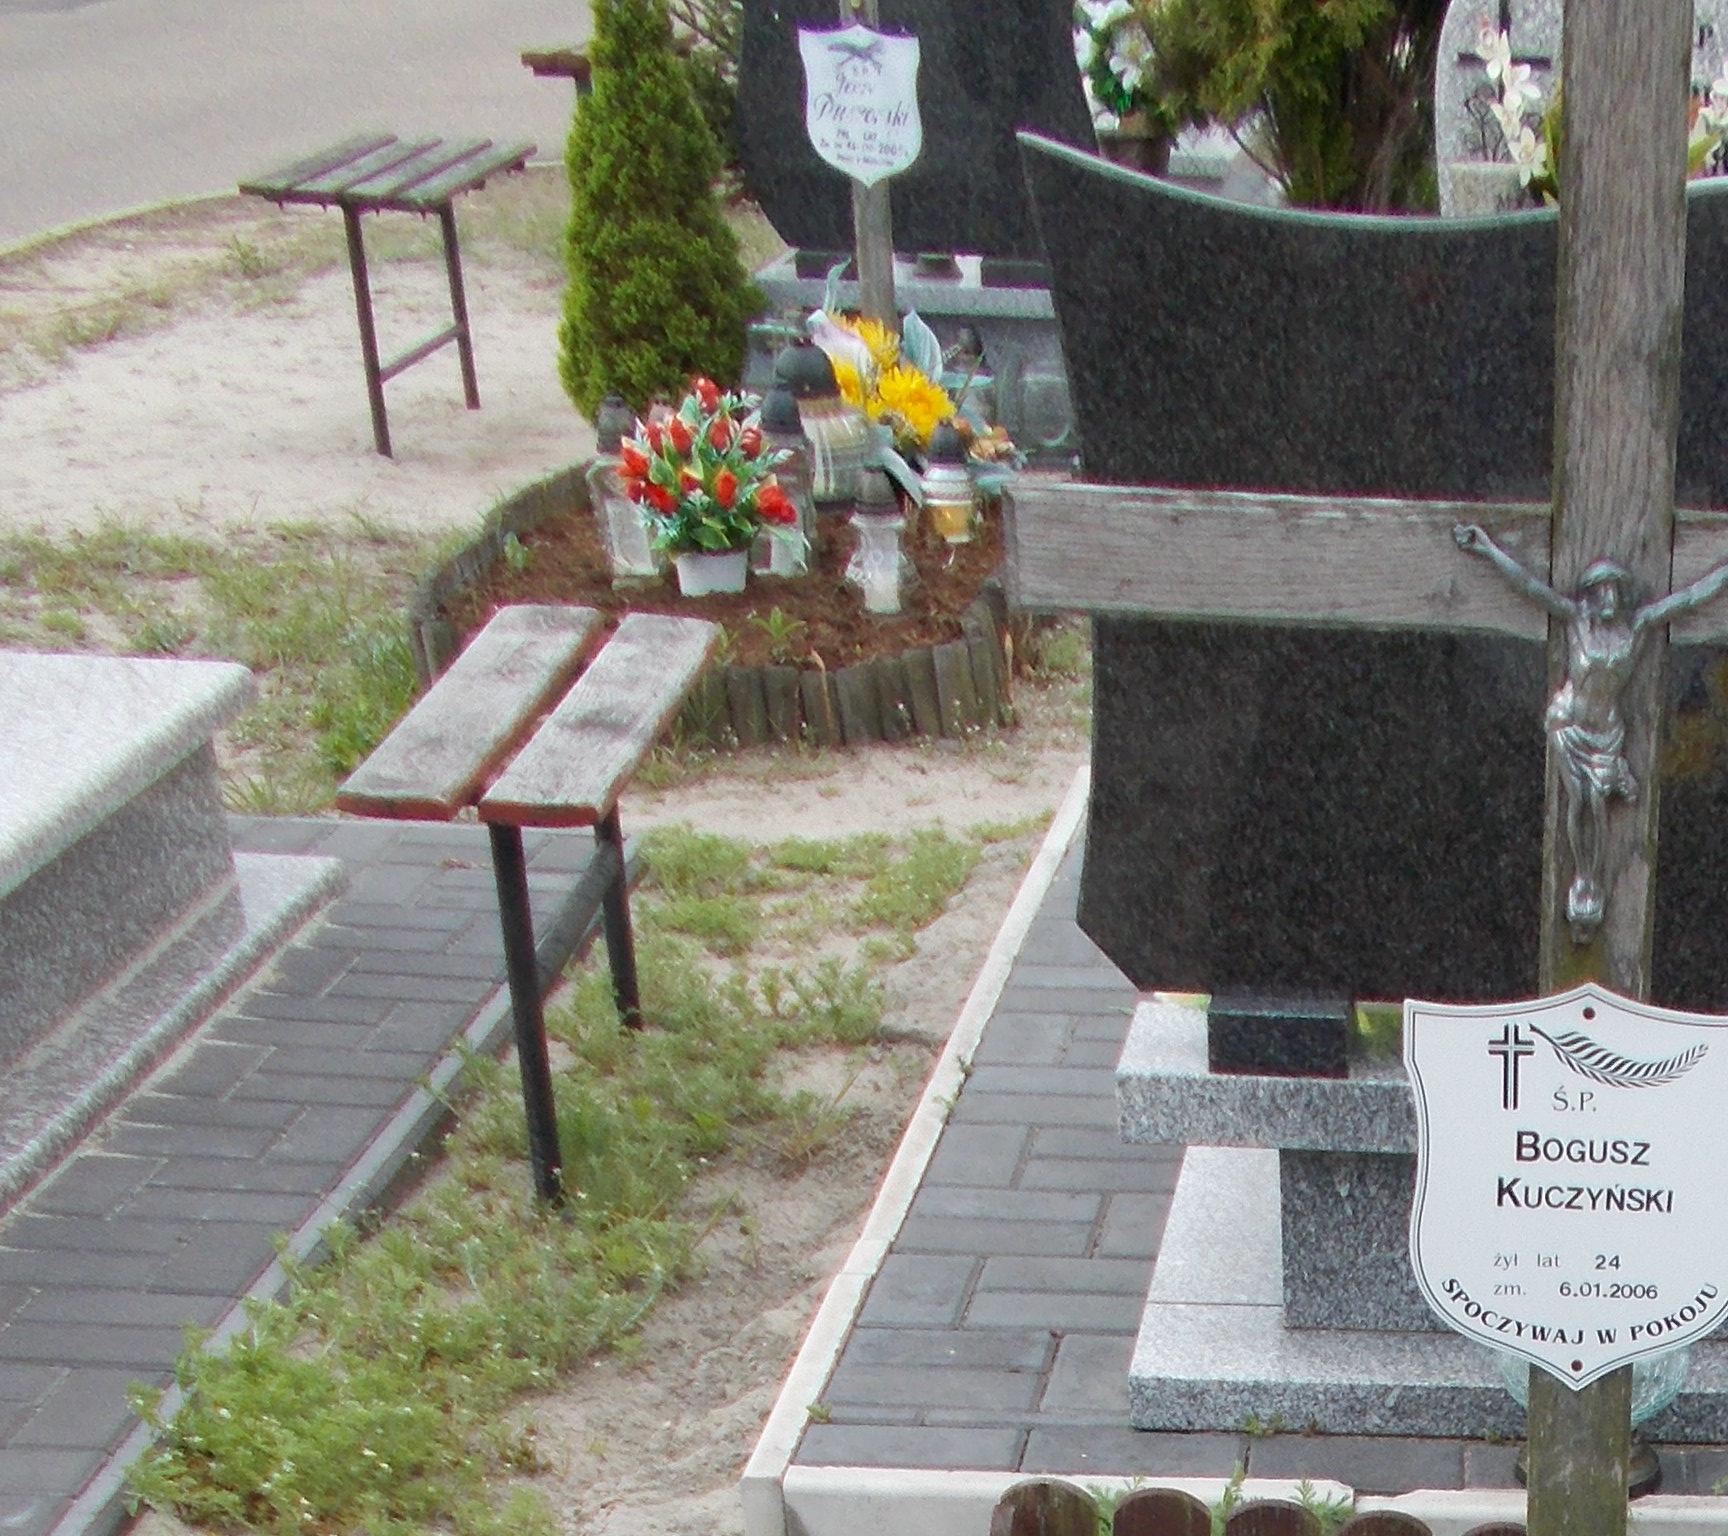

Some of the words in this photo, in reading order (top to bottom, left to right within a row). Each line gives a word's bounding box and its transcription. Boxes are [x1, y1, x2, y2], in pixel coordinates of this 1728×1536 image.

[1552, 1085, 1597, 1112] Ś.P.
[1492, 1252, 1519, 1270] żył
[1536, 1252, 1561, 1268] lat
[1594, 1255, 1622, 1270] 24
[1492, 1284, 1527, 1297] zm.
[1558, 1282, 1659, 1300] 6.01.2006
[1441, 1277, 1584, 1345] SPOCZYWAJ
[1598, 1329, 1618, 1345] W
[1630, 1283, 1719, 1341] POKOJU
